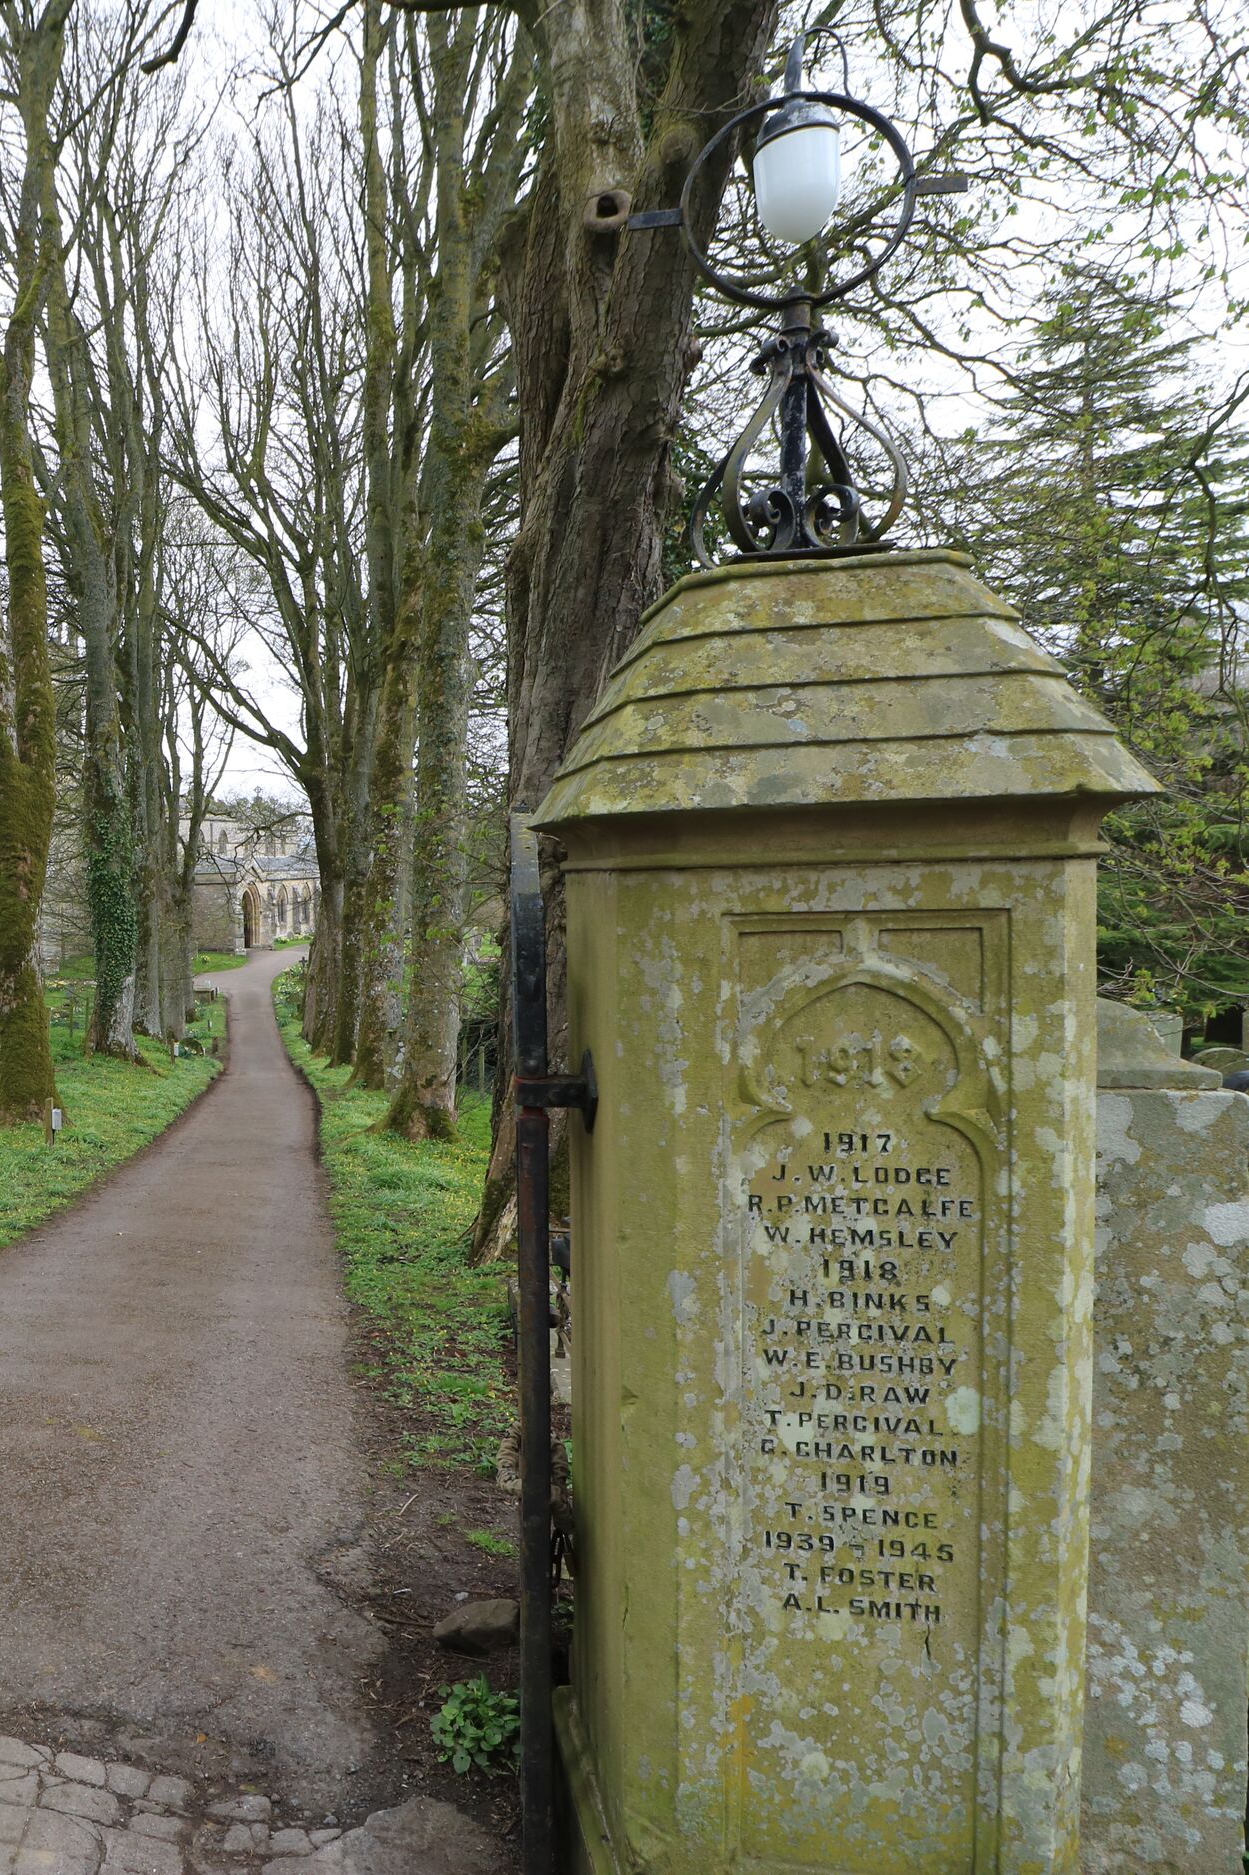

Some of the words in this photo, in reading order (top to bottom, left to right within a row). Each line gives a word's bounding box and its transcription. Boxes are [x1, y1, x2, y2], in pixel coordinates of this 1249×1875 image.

[823, 1132, 891, 1153] 1917
[822, 1258, 898, 1281] 1918
[820, 1472, 890, 1496] 1919
